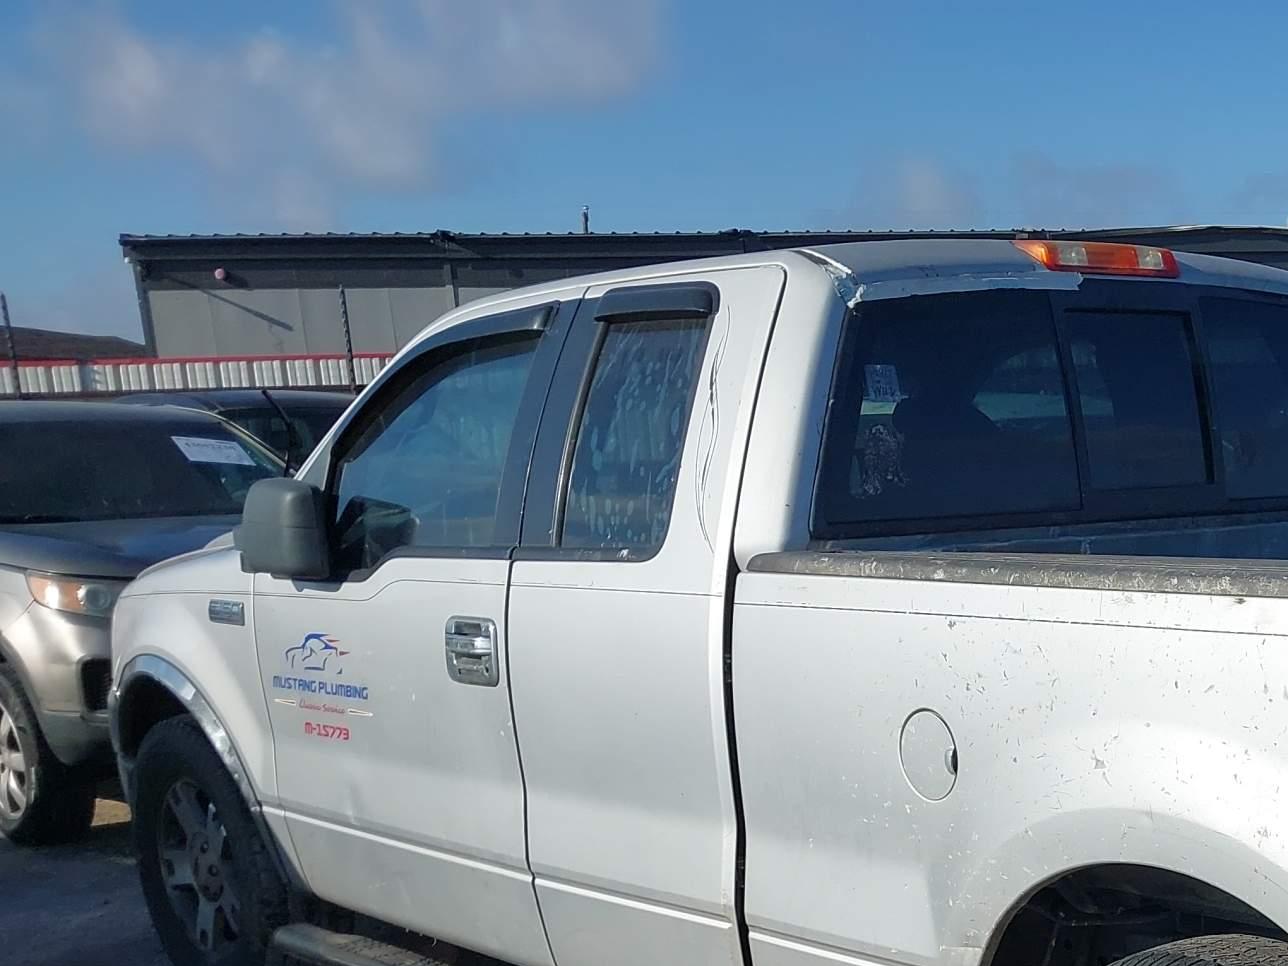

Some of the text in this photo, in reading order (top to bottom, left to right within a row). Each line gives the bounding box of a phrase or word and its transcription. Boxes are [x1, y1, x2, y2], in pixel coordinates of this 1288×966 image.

[273, 675, 368, 700] MUSTANG PLUMBING
[304, 722, 350, 740] M-15773
